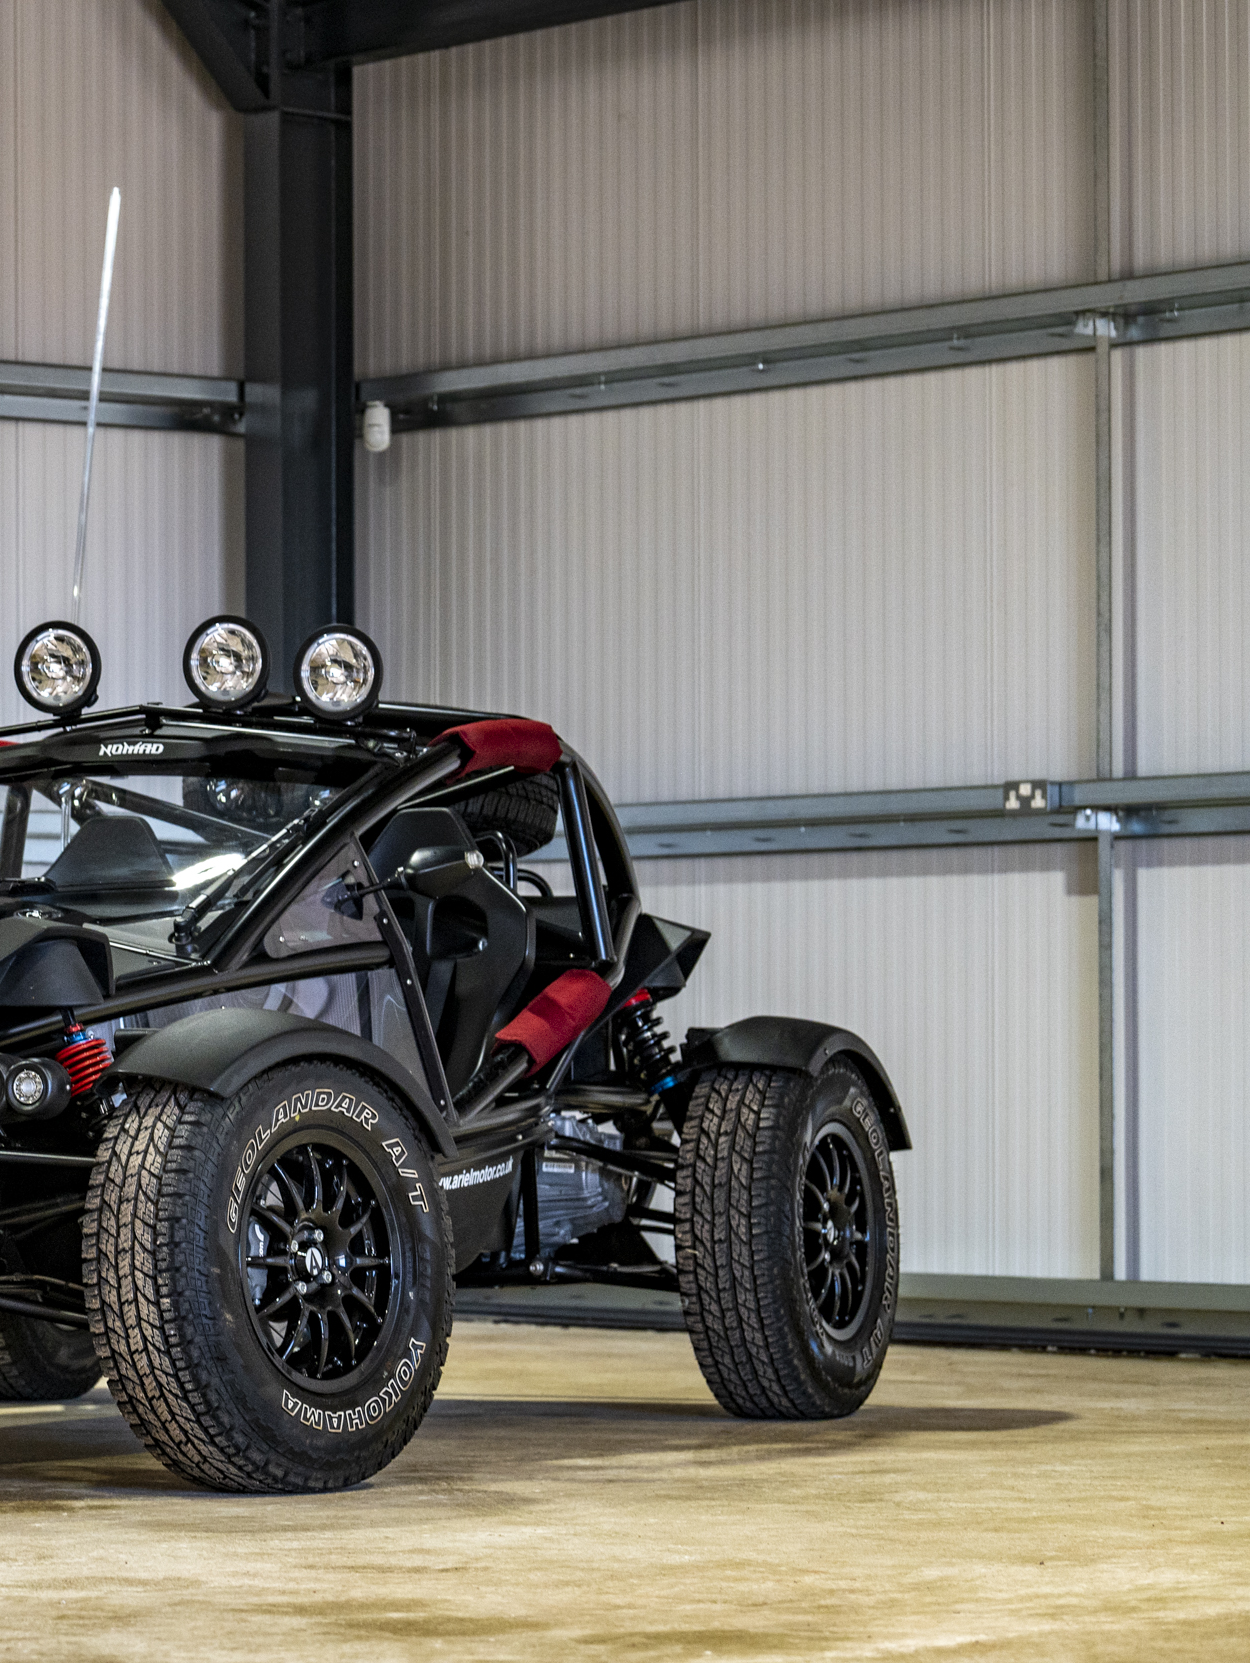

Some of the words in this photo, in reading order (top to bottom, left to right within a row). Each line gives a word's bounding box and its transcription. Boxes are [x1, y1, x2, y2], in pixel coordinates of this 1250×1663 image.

[99, 741, 165, 757] NOMAD
[226, 1088, 379, 1233] GEOLANDAR
[381, 1137, 430, 1213] A/T
[281, 1337, 427, 1433] YOKOHAMA
